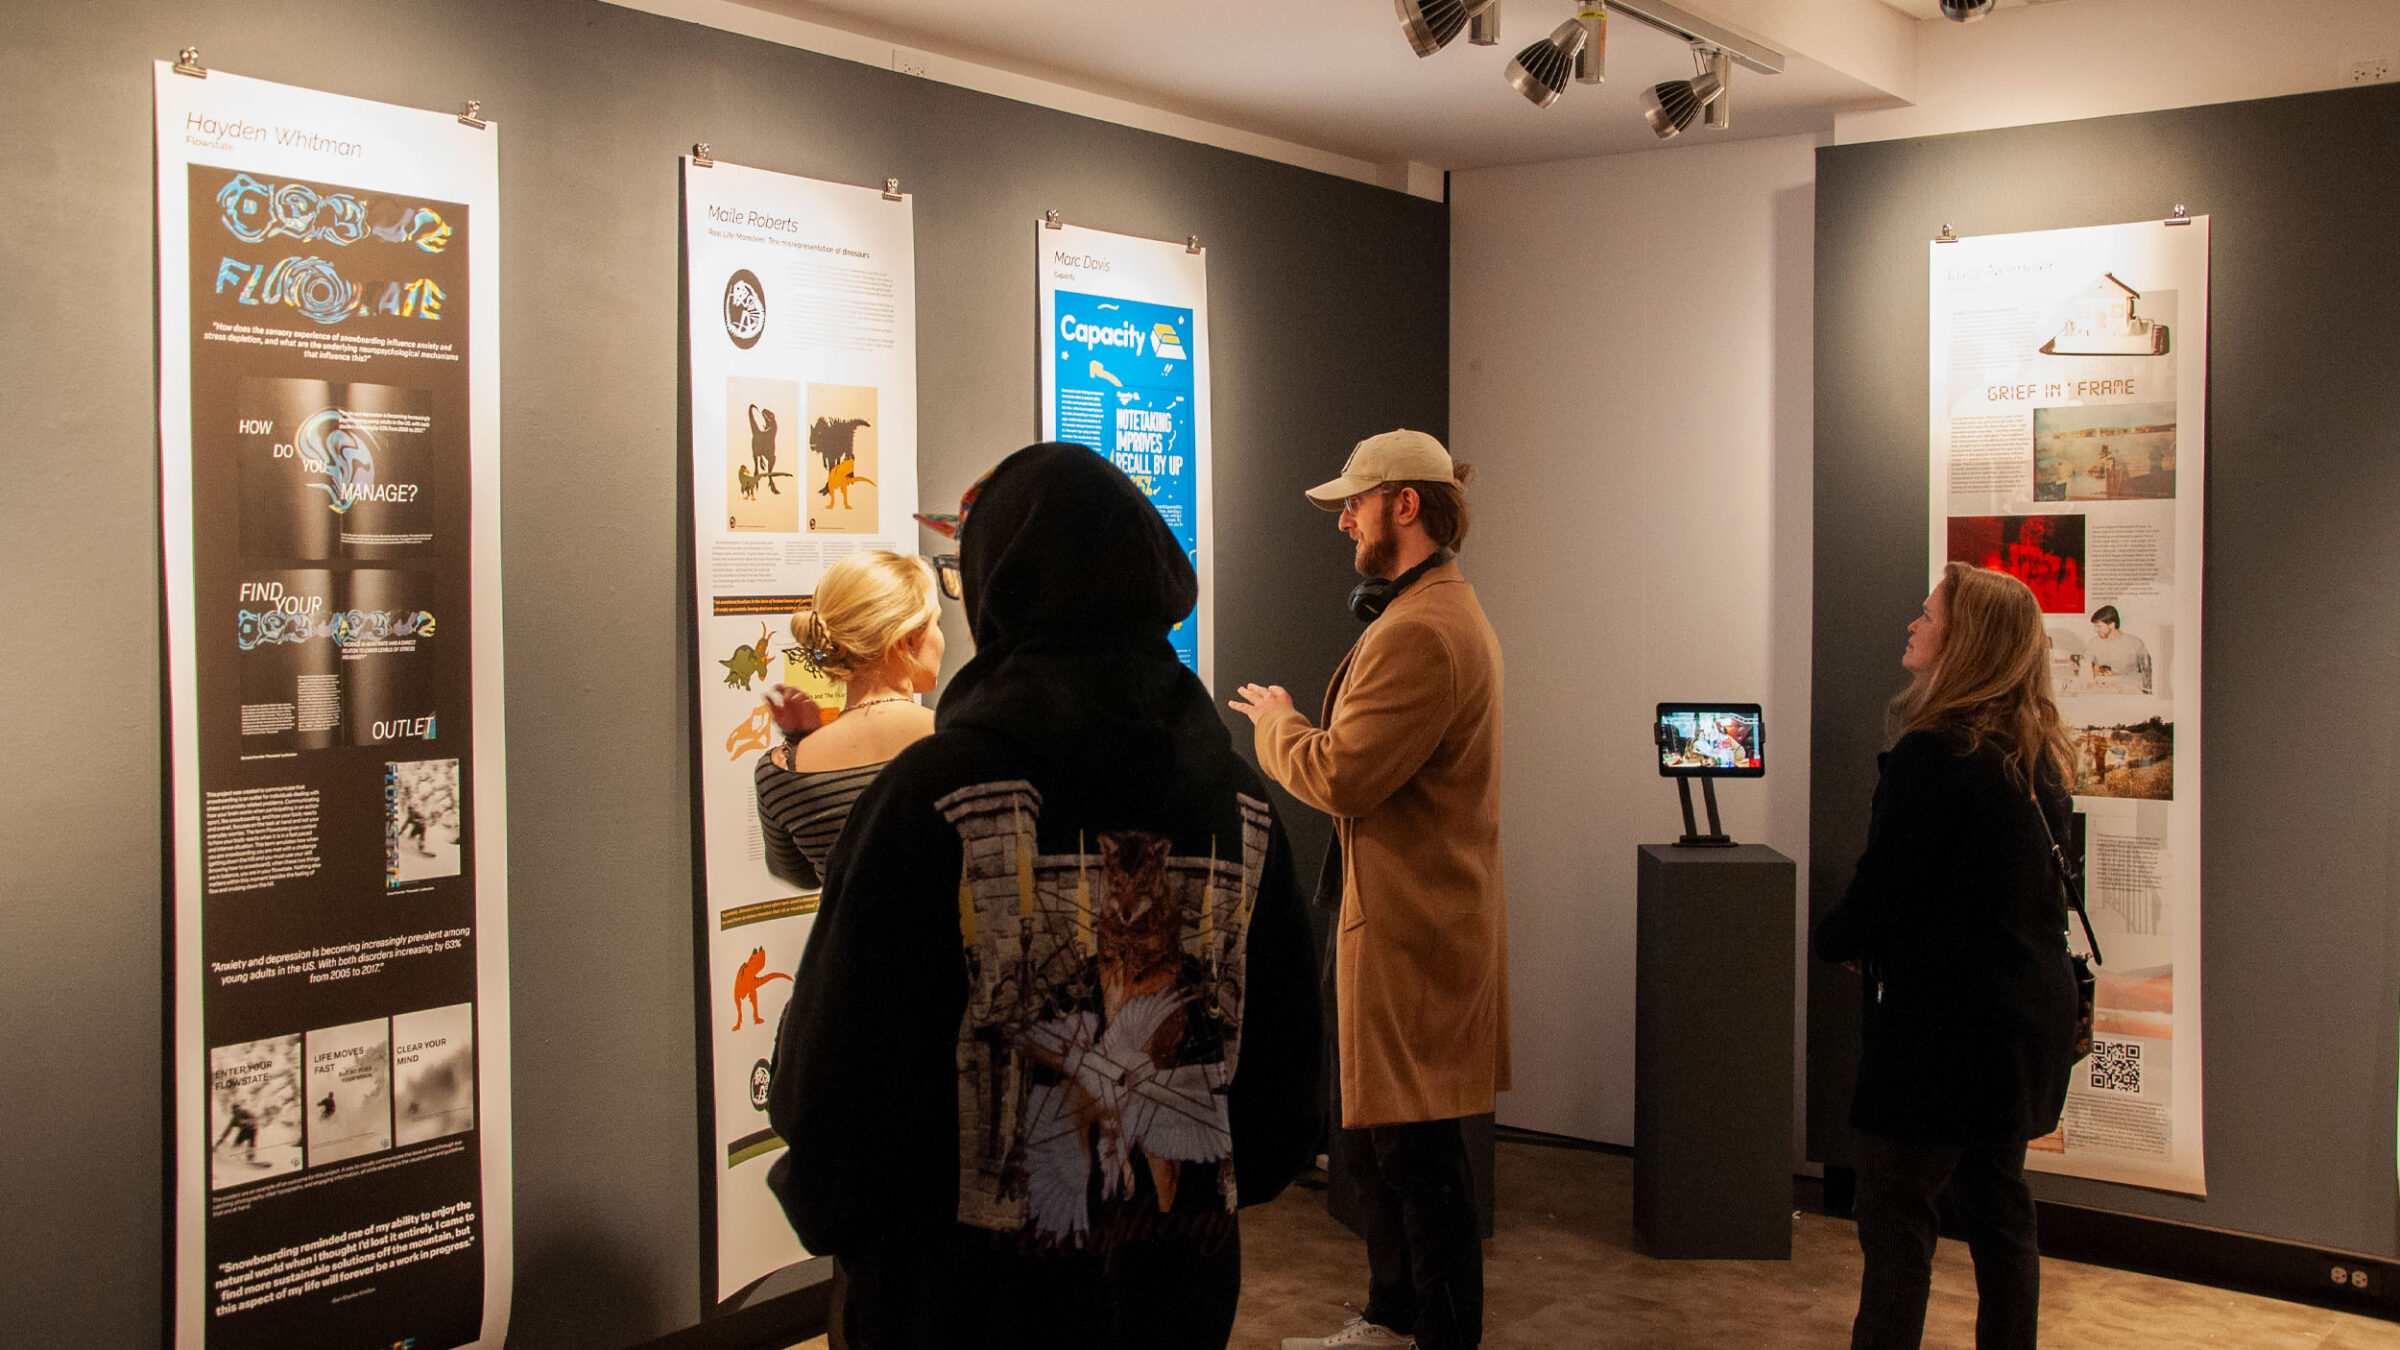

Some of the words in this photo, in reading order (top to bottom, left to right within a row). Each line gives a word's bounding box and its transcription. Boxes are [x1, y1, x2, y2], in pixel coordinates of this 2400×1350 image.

[187, 112, 266, 140] Hayden
[276, 128, 361, 156] Whitman
[709, 205, 743, 224] Maile
[748, 211, 798, 232] Roberts
[1055, 251, 1080, 267] Marc
[1084, 255, 1109, 272] Davis
[1060, 315, 1146, 356] Capacity
[1987, 384, 2037, 401] GRIEF
[2046, 384, 2061, 398] IN
[2077, 378, 2135, 396] FRAME
[239, 420, 272, 434] HOW
[1116, 408, 1172, 432] NOTETAKING
[273, 444, 294, 458] DO
[1116, 430, 1163, 453] IMPROVES
[302, 460, 326, 473] YOU
[1116, 452, 1152, 474] RECALL
[1154, 454, 1167, 475] BY
[1169, 455, 1183, 476] UP
[341, 483, 418, 502] MANAGE?
[240, 582, 283, 601] FIND
[276, 596, 322, 614] YOUR
[372, 716, 434, 739] OUTLET
[212, 960, 247, 971] "Anxiety
[247, 956, 264, 967] and
[265, 951, 311, 964] depression
[312, 948, 319, 957] is
[321, 944, 360, 956] becoming
[362, 936, 407, 949] increasingly
[408, 931, 442, 943] prevalent
[444, 928, 470, 937] among
[222, 973, 248, 985] young
[250, 968, 276, 979] adults
[278, 966, 285, 975] in
[287, 964, 301, 974] the
[302, 961, 316, 971] US.
[318, 958, 336, 968] With
[338, 955, 356, 966] both
[358, 951, 394, 962] disorders
[395, 945, 433, 956] increasing
[435, 942, 443, 951] by
[445, 939, 461, 949] 63%
[310, 973, 329, 983] from
[330, 968, 351, 980] 2005
[352, 968, 360, 976] to
[314, 1052, 332, 1063] LIFE
[334, 1047, 364, 1058] MOVES
[397, 1043, 423, 1054] CLEAR
[425, 1038, 446, 1048] YOUR
[215, 1066, 245, 1079] ENTER
[247, 1061, 272, 1072] YOUR
[314, 1064, 335, 1074] FAST
[397, 1055, 419, 1064] MIND
[215, 1074, 268, 1090] FLOWSTATE
[219, 1247, 299, 1272] "Snowboarding
[300, 1232, 347, 1252] reminded
[348, 1230, 363, 1240] me
[364, 1224, 374, 1235] of
[375, 1223, 390, 1232] my
[391, 1215, 420, 1228] ability
[420, 1212, 430, 1221] to
[431, 1206, 456, 1218] enjoy
[456, 1202, 471, 1211] the
[216, 1270, 254, 1288] natural
[254, 1262, 284, 1278] world
[285, 1257, 312, 1269] when
[313, 1253, 317, 1262] I
[318, 1244, 357, 1260] thought
[358, 1239, 370, 1250] I'd
[370, 1235, 388, 1247] lost
[390, 1233, 397, 1242] it
[398, 1224, 434, 1239] entirely.
[435, 1221, 440, 1229] I
[440, 1216, 464, 1228] came
[465, 1213, 474, 1221] to
[221, 1286, 243, 1300] find
[244, 1281, 271, 1294] more
[273, 1265, 330, 1286] sustainable
[332, 1253, 376, 1270] solutions
[376, 1246, 391, 1258] off
[391, 1244, 408, 1254] the
[409, 1232, 454, 1249] mountain,
[455, 1226, 470, 1237] but
[216, 1303, 237, 1315] this
[238, 1293, 274, 1309] aspect
[276, 1288, 287, 1299] of
[288, 1286, 303, 1296] my
[304, 1280, 320, 1291] life
[322, 1274, 339, 1286] will
[339, 1266, 374, 1281] forever
[375, 1262, 388, 1271] be
[389, 1260, 395, 1268] a
[396, 1252, 419, 1265] work
[420, 1250, 429, 1259] in
[429, 1237, 474, 1258] progress."
